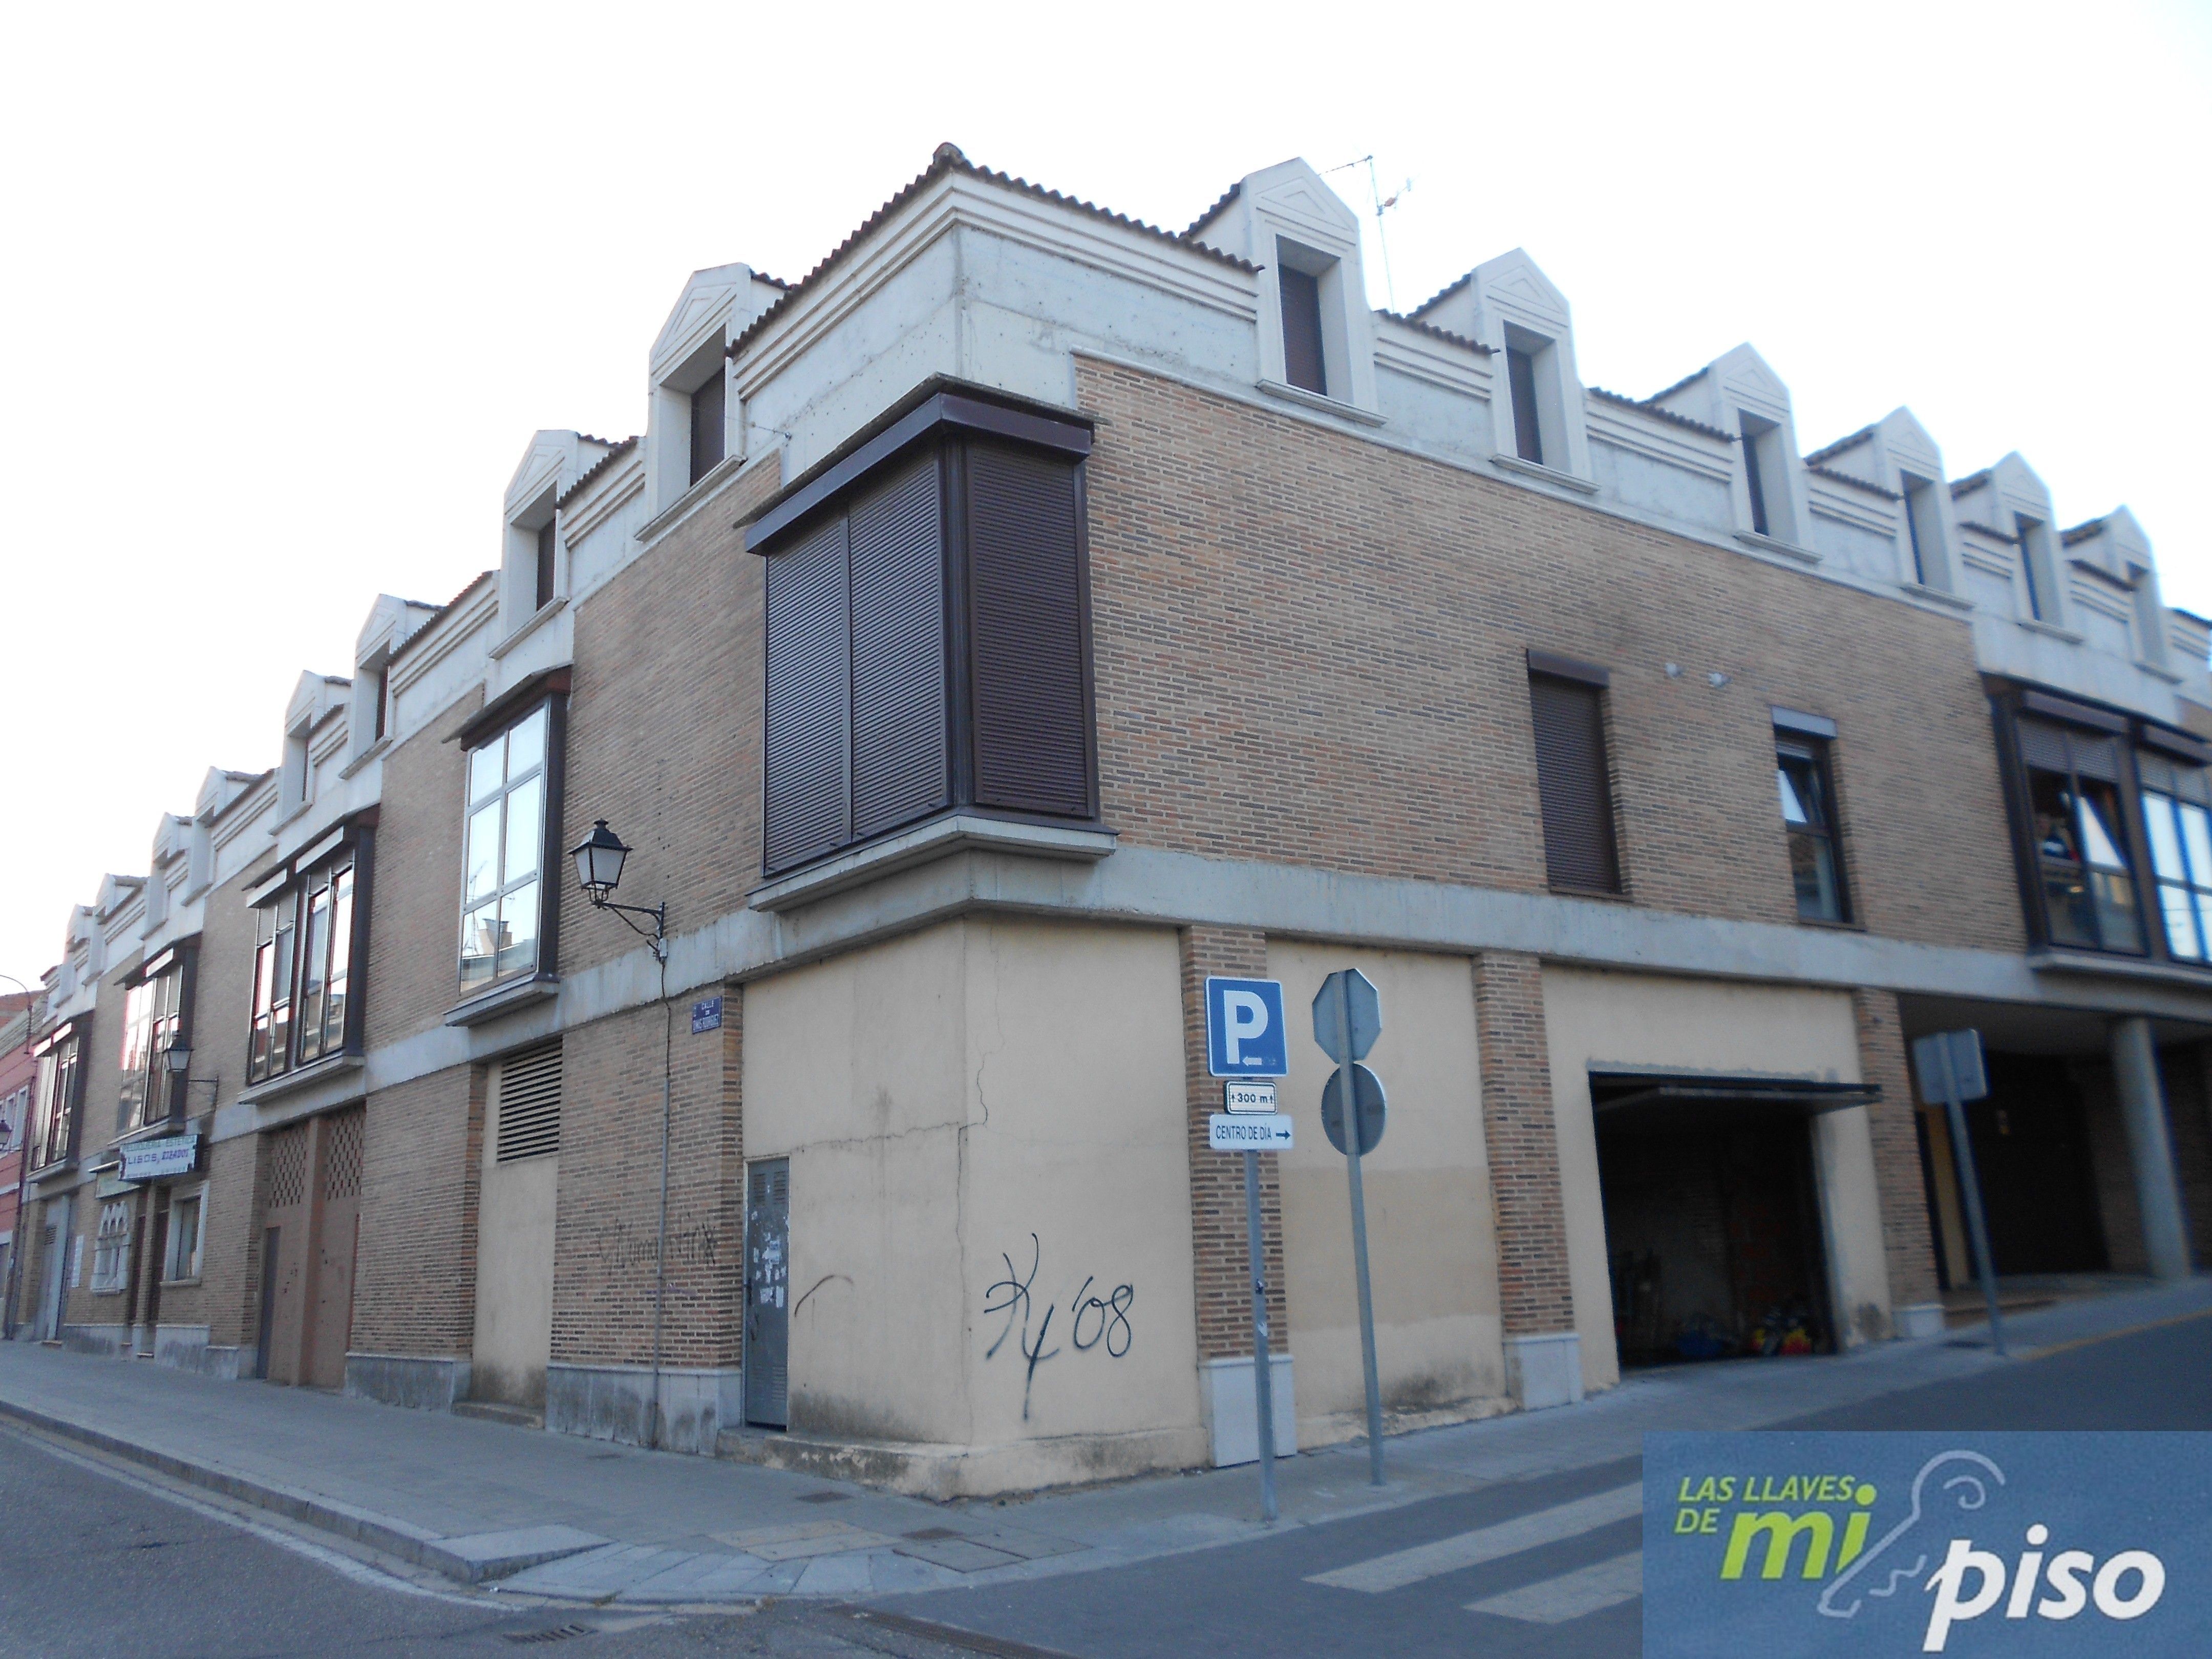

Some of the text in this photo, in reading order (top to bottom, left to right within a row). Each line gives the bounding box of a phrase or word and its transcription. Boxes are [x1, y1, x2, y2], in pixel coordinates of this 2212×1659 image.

[1223, 990, 1268, 1064] P
[1237, 1093, 1256, 1102] 300
[1216, 1123, 1272, 1140] CENTRO DE DÍA
